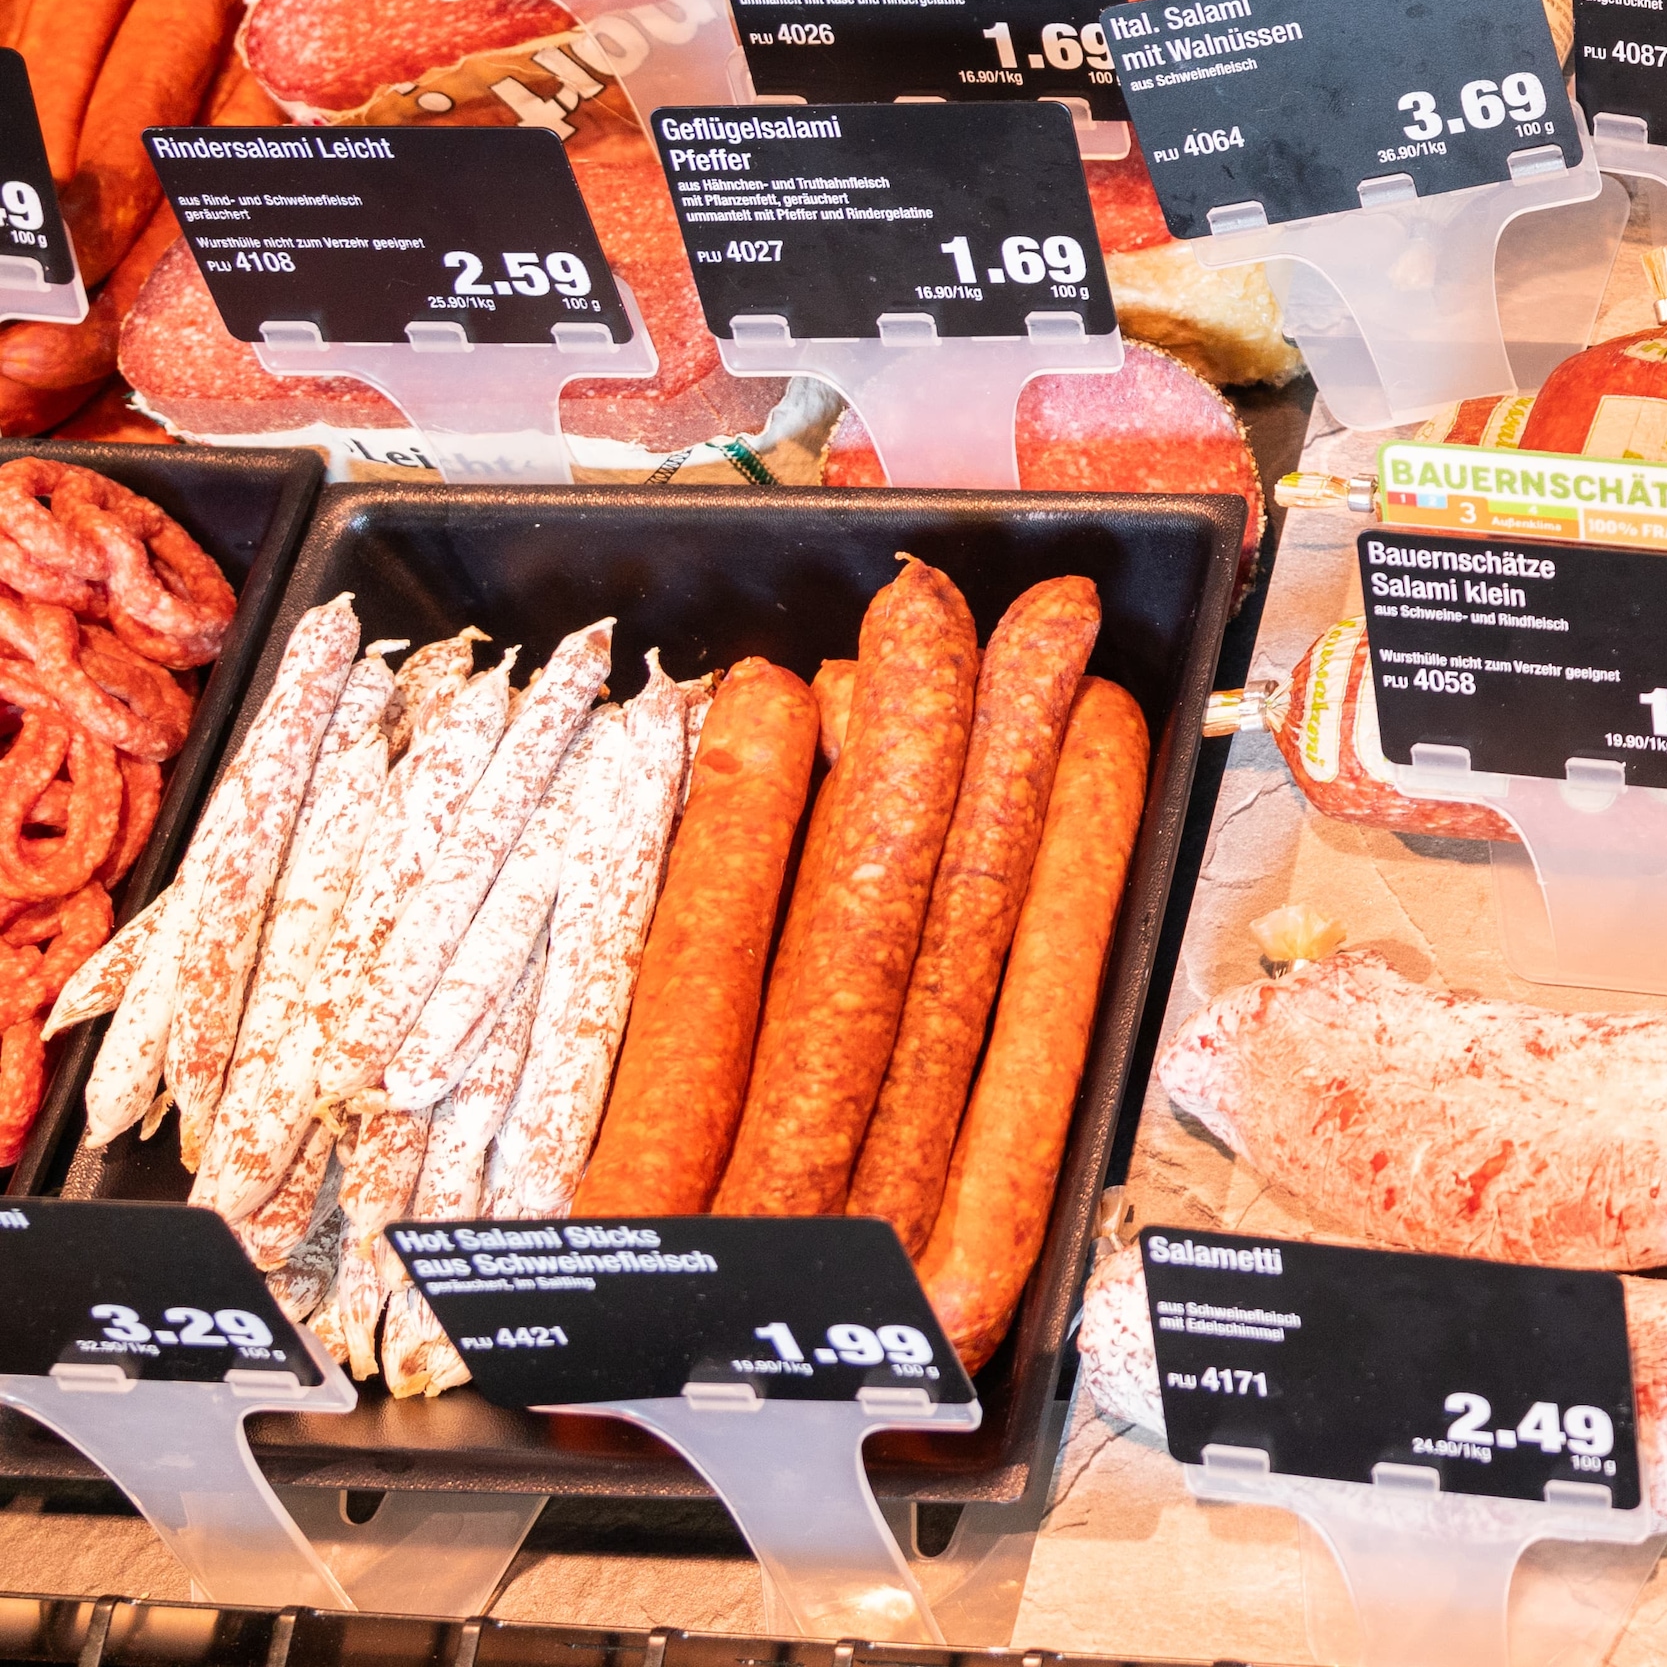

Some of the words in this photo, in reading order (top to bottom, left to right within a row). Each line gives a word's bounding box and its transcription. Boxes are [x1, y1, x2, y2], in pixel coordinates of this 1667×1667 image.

[777, 23, 835, 45] 4026
[1109, 12, 1161, 41] Ital.
[1121, 43, 1167, 72] mit
[1169, 19, 1303, 62] Walnüssen
[1397, 71, 1547, 141] 3.69
[661, 115, 842, 145] Geflügelsalami
[1183, 125, 1246, 157] 4064
[152, 136, 314, 159] Rindersalami
[315, 136, 395, 159] Leicht
[669, 148, 752, 172] Pfeffer
[236, 251, 296, 273] 4108
[726, 240, 784, 263] 4027
[940, 235, 1087, 285] 1.69
[443, 250, 592, 297] 2.59
[1459, 502, 1478, 524] 3
[1368, 541, 1556, 578] Bauernschätze
[1370, 572, 1458, 602] Salami
[1464, 579, 1526, 608] klein
[1413, 668, 1477, 695] 4058
[395, 1229, 456, 1253] Hot
[454, 1226, 563, 1251] Salami
[564, 1225, 661, 1248] Sticks
[413, 1258, 472, 1278] aus
[472, 1250, 718, 1276] Schweinefleisch
[1148, 1235, 1283, 1275] Salametti
[91, 1303, 273, 1349] 3.29
[496, 1325, 569, 1348] 4421
[755, 1322, 934, 1366] 1.99
[1200, 1366, 1268, 1397] 4171
[1444, 1392, 1614, 1456] 2.49
